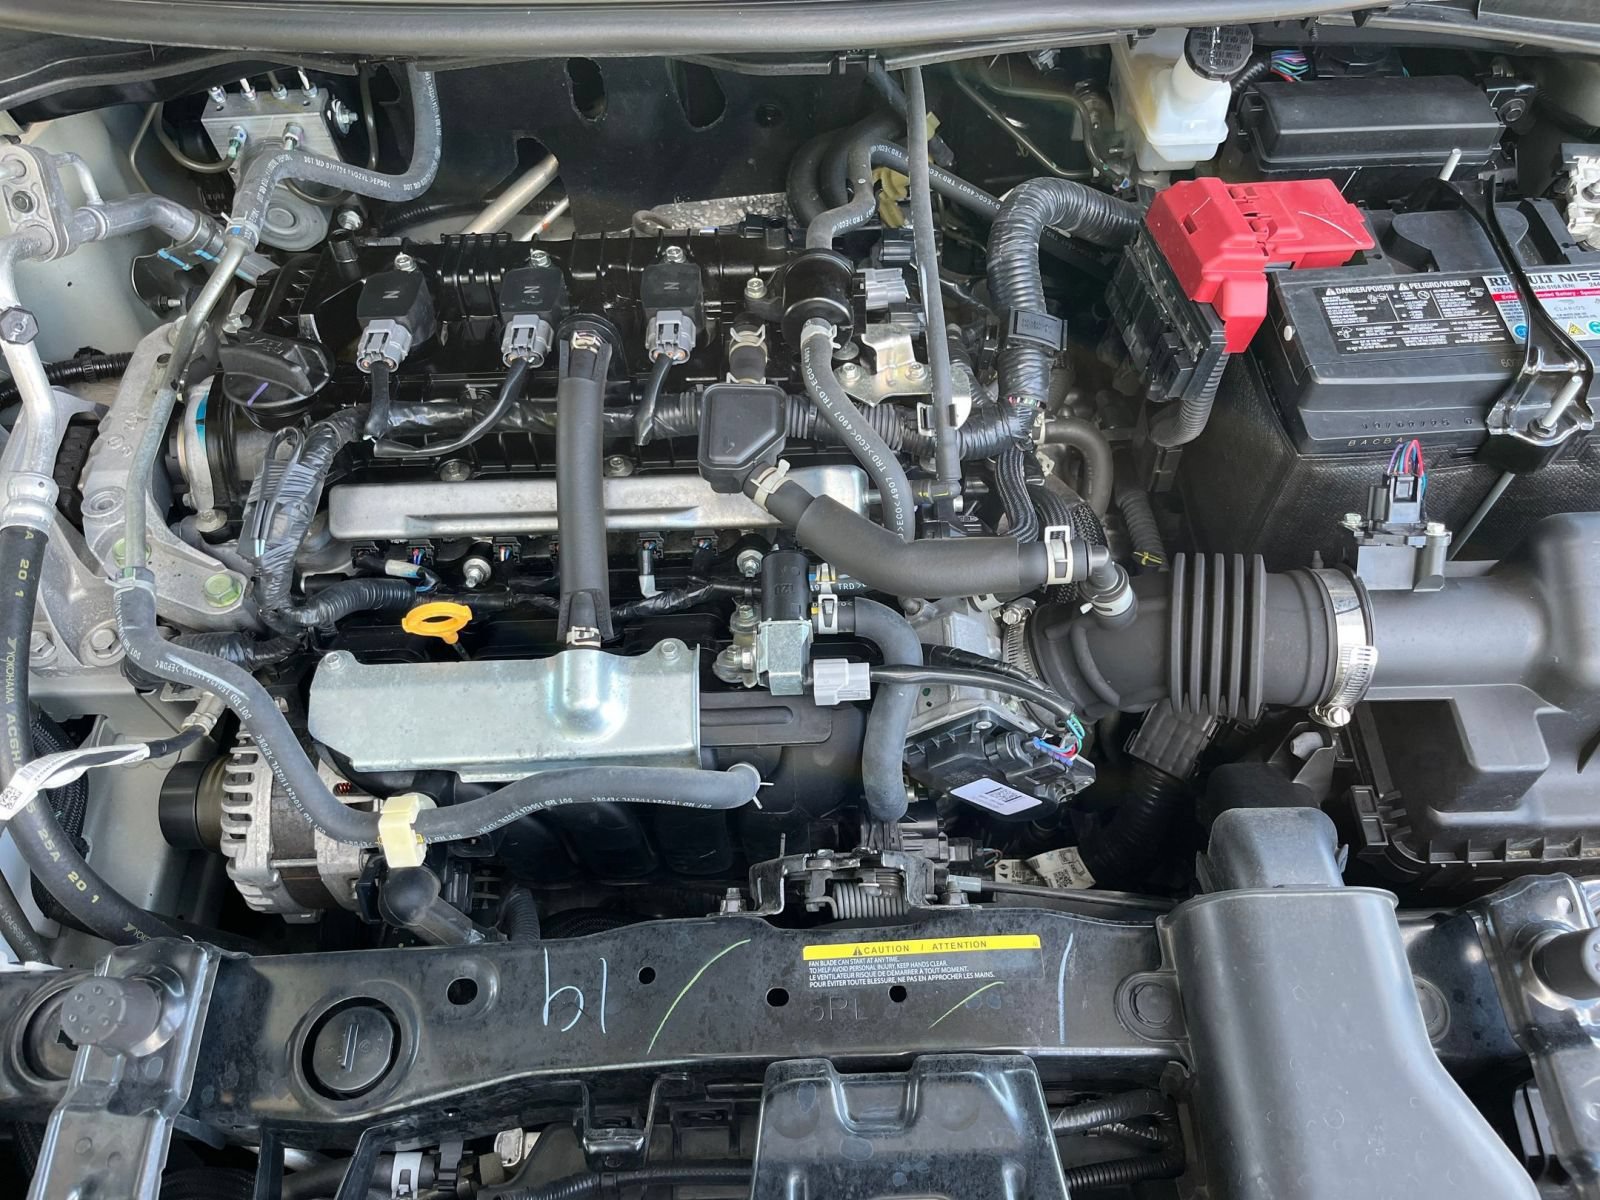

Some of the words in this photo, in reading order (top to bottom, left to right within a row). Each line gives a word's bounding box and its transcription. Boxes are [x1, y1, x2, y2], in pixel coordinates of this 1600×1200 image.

[1489, 275, 1553, 286] REULT
[1335, 284, 1395, 294] DANGER/POISON
[17, 558, 28, 580] 20
[5, 651, 15, 704] YOKOHAMA
[66, 869, 89, 893] 20
[90, 893, 101, 905] 1
[864, 944, 910, 954] CAUTION
[932, 941, 987, 951] ATTENTION
[820, 959, 837, 967] BLADE
[817, 972, 855, 980] VENTILATEUR
[855, 970, 877, 978] RISQUE
[925, 966, 940, 974] TOUT
[809, 980, 826, 988] POUR
[847, 978, 866, 986] TOUTE
[928, 973, 963, 981] APPROCHER
